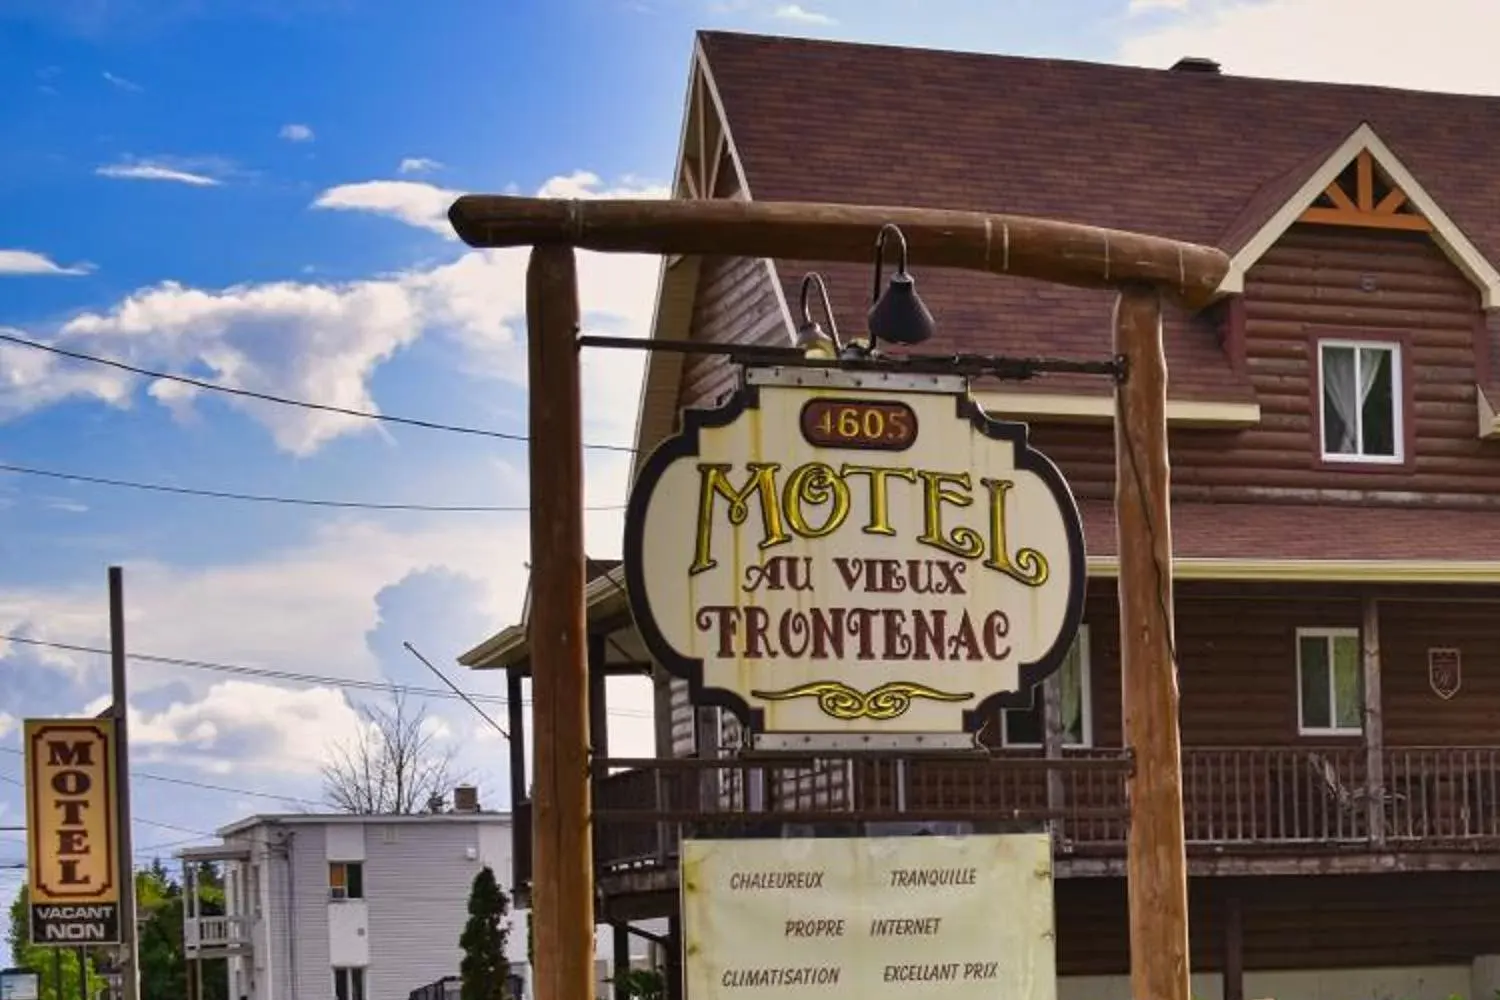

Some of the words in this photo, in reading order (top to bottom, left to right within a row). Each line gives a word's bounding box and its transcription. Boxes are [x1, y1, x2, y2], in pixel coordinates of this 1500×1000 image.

[688, 461, 1050, 588] MOTEL
[742, 556, 814, 593] AU
[832, 557, 967, 595] VIEUX
[696, 605, 1013, 662] FRONTENAC
[46, 740, 96, 886] MOTEL
[730, 870, 824, 891] CHALEUREUX
[890, 867, 977, 887] TRANQUILLE
[35, 905, 113, 920] VACANT
[46, 923, 105, 940] NON
[784, 918, 847, 938] PROPRE
[870, 917, 942, 937] INTERNET
[721, 966, 841, 988] CLIMATISATION
[883, 963, 959, 984] EXCELLANT
[963, 961, 999, 981] PRIX
